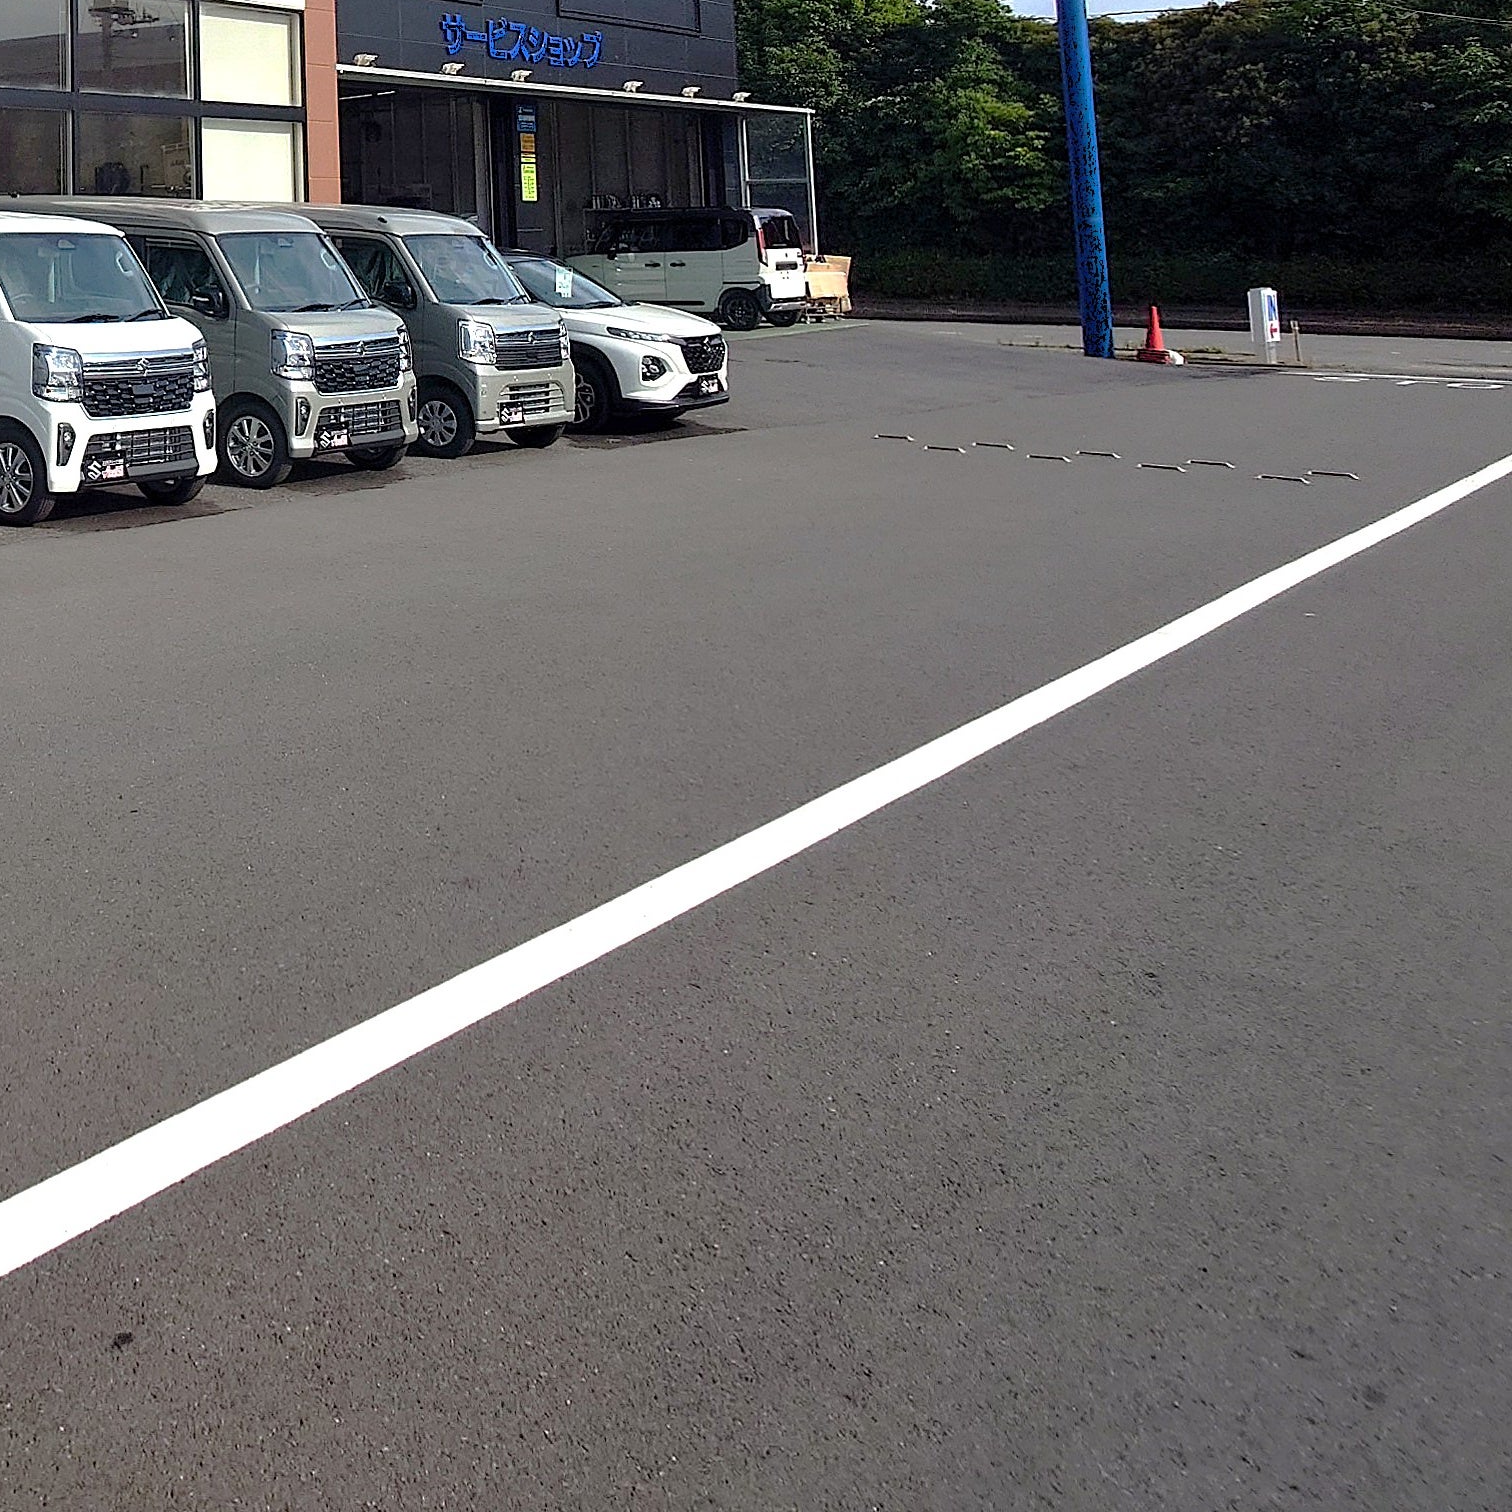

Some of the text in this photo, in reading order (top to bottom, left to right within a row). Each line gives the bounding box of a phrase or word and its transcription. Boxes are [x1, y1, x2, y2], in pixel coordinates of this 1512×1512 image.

[440, 12, 603, 69] サービスショップ
